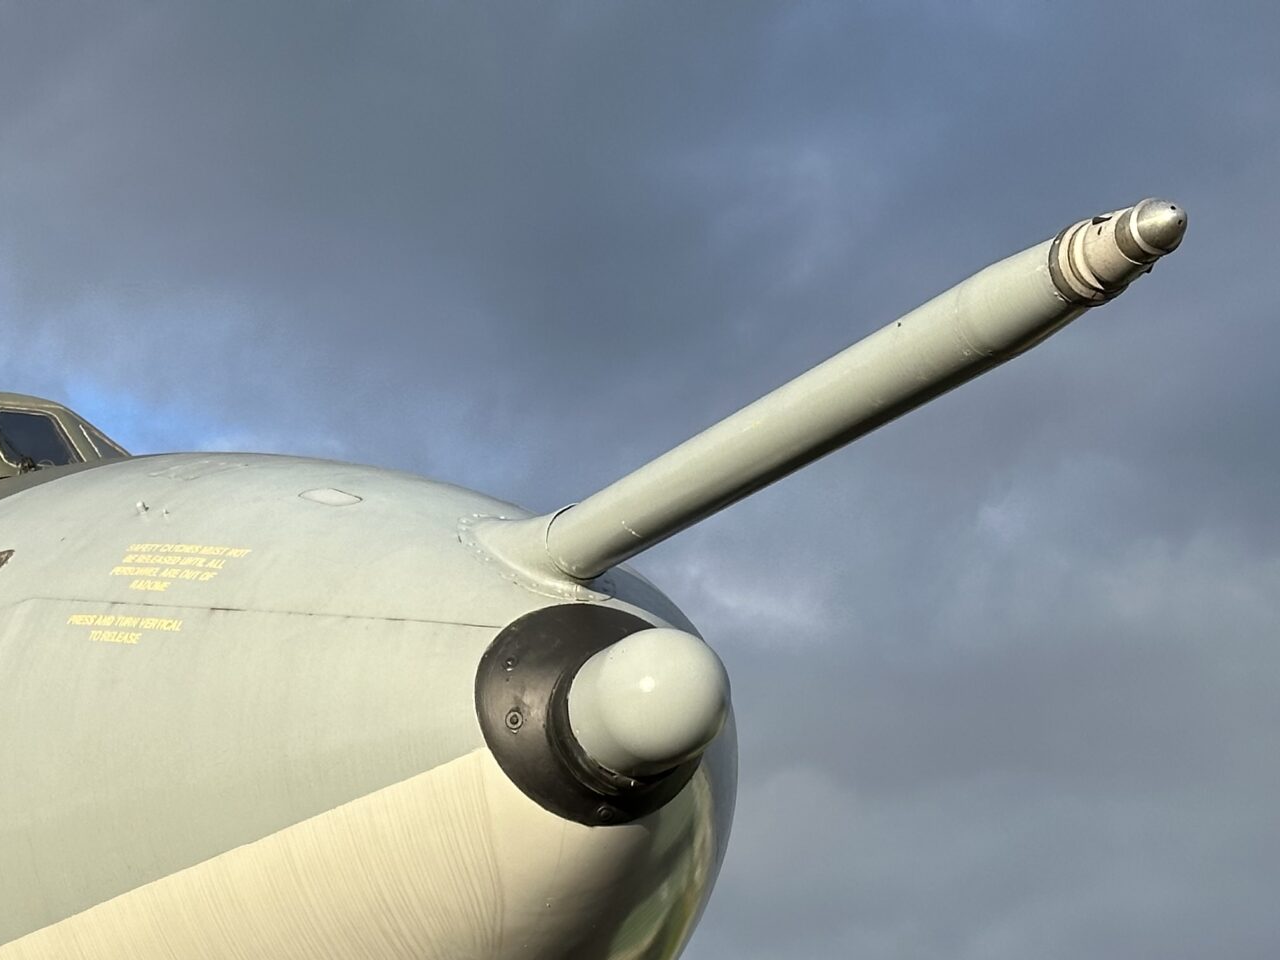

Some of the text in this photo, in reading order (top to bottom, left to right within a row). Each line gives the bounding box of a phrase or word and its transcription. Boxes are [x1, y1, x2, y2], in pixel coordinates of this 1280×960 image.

[226, 548, 251, 558] NOT
[206, 559, 225, 569] ALL
[159, 568, 181, 578] ARE
[178, 569, 202, 580] OUT
[199, 571, 218, 581] OF
[66, 614, 184, 632] PRESS AND TURN VERTICAL
[88, 630, 143, 644] TO RELEASE
